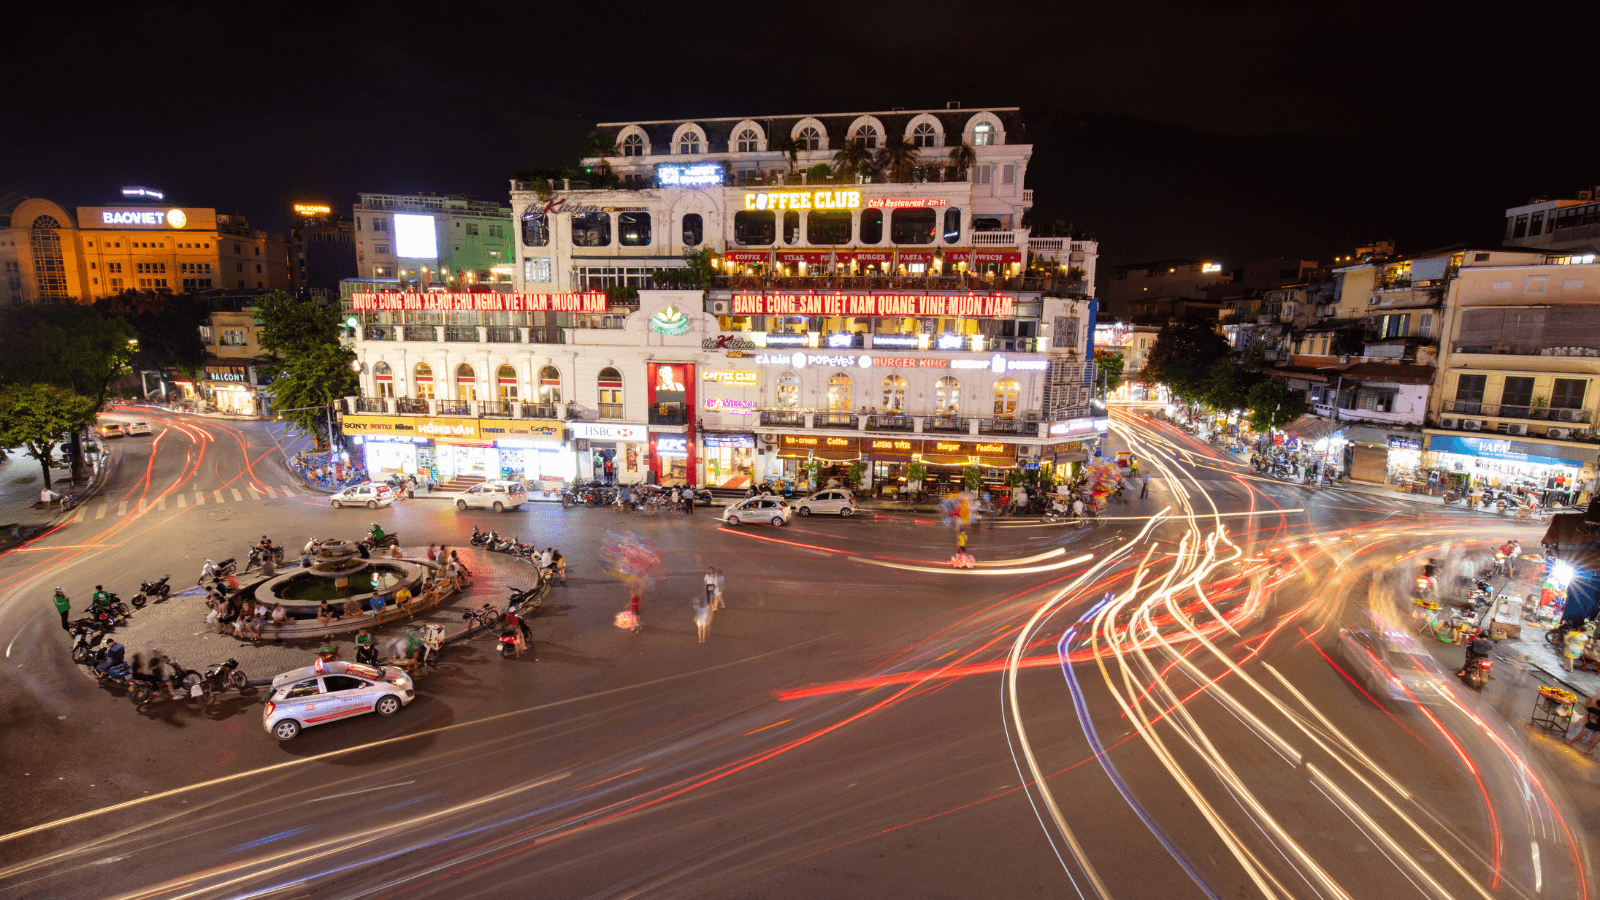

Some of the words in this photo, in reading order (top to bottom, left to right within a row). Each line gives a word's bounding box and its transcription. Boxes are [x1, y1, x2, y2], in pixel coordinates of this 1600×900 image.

[814, 190, 861, 209] CLUB
[885, 198, 925, 208] Restaurant
[102, 210, 165, 224] BAOVIET
[352, 289, 377, 310] NƯỚC
[379, 288, 402, 313] CỘNG
[404, 289, 422, 310] HÒA
[423, 290, 436, 310] XÃ
[437, 287, 453, 313] HỘI
[454, 288, 473, 310] CHỦ
[474, 289, 503, 311] NGHĨA
[504, 289, 525, 314] VIỆT
[526, 293, 548, 311] NAM
[551, 289, 581, 311] MUÔN
[583, 289, 607, 311] NĂM
[734, 289, 763, 314] ĐẢNG
[766, 290, 796, 317] CỘNG
[799, 289, 822, 314] SẢN
[824, 290, 847, 317] VIỆT
[850, 295, 875, 314] NAM
[878, 295, 915, 316] QUANG
[919, 296, 946, 315] VINH
[948, 291, 982, 316] MUÔN
[984, 292, 1013, 318] NĂM
[702, 337, 717, 349] the
[717, 335, 756, 349] Kitchen
[873, 357, 916, 368] BURGER
[919, 358, 947, 368] KING
[210, 372, 245, 382] BALCONY
[394, 423, 414, 431] Nikon
[585, 426, 614, 437] HSBC
[657, 438, 687, 450] KFC
[826, 437, 848, 446] Coffee
[937, 442, 960, 452] Burger
[976, 444, 1003, 453] Fastfood
